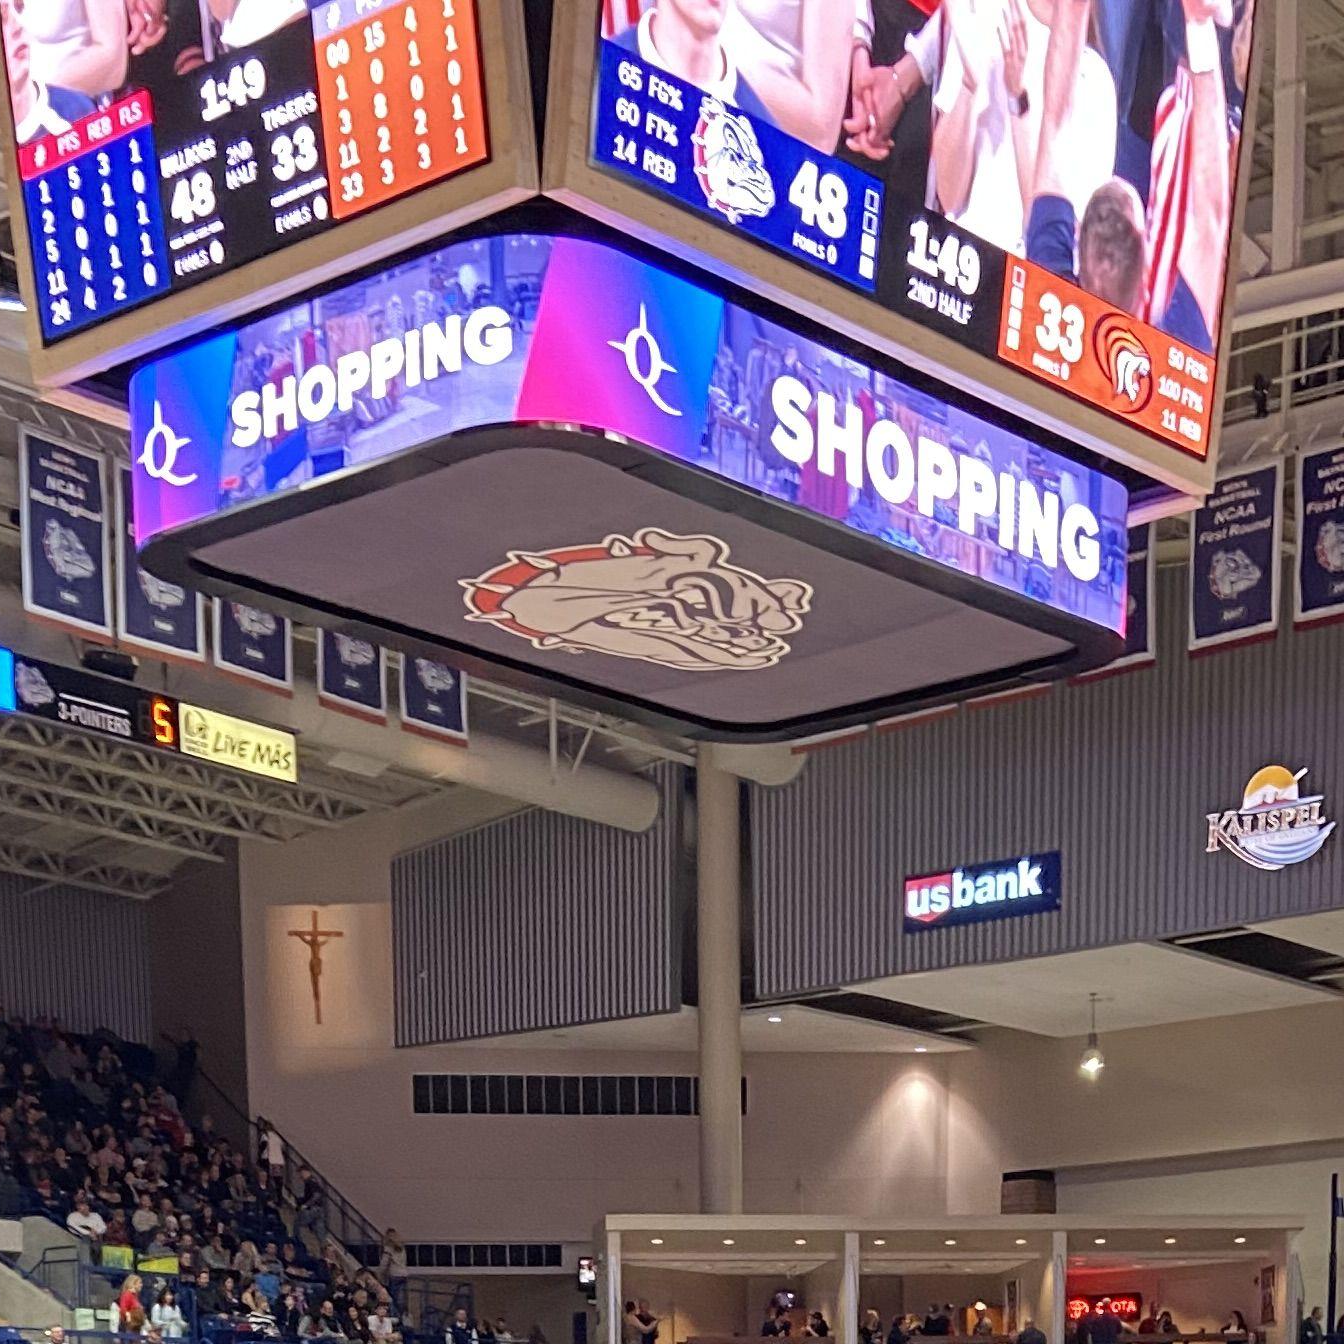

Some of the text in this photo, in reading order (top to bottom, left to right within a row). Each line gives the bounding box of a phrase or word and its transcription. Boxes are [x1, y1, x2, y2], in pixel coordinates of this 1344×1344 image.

[363, 21, 385, 53] 15
[336, 24, 458, 101] 1 0 1 1
[618, 61, 683, 111] 65 FG%
[199, 58, 267, 122] 1:49
[261, 91, 318, 131] TIGERS
[338, 109, 352, 134] 3
[410, 75, 424, 101] 0
[447, 59, 461, 86] 0
[57, 130, 81, 155] PTS
[87, 116, 113, 142] REB
[377, 126, 391, 153] 2
[414, 109, 428, 135] 2
[452, 93, 465, 120] 1
[616, 97, 678, 146] 60 FT%
[39, 139, 142, 204] 1 5 3 1
[271, 126, 318, 181] 33
[341, 127, 468, 201] 33 3 3 1
[613, 134, 676, 183] 14 REB
[42, 169, 145, 234] 2 0 1 0
[171, 171, 216, 224] 48
[788, 160, 848, 239] 48
[76, 200, 150, 250] 0 0 1
[110, 245, 123, 269] 1
[140, 233, 154, 257] 1
[826, 244, 838, 265] 0
[907, 219, 981, 295] 1:49
[113, 262, 156, 300] 2 0
[907, 276, 973, 325] 2ND HALF
[1035, 292, 1085, 363] 33
[229, 305, 514, 449] SHOPPING
[1158, 375, 1182, 401] 100
[1161, 408, 1177, 432] 11
[769, 374, 1101, 582] SHOPPING
[1214, 502, 1256, 525] NCAA
[57, 699, 133, 739] 3-POINTERS
[152, 699, 176, 744] 5
[1205, 801, 1327, 853] KALISPEL
